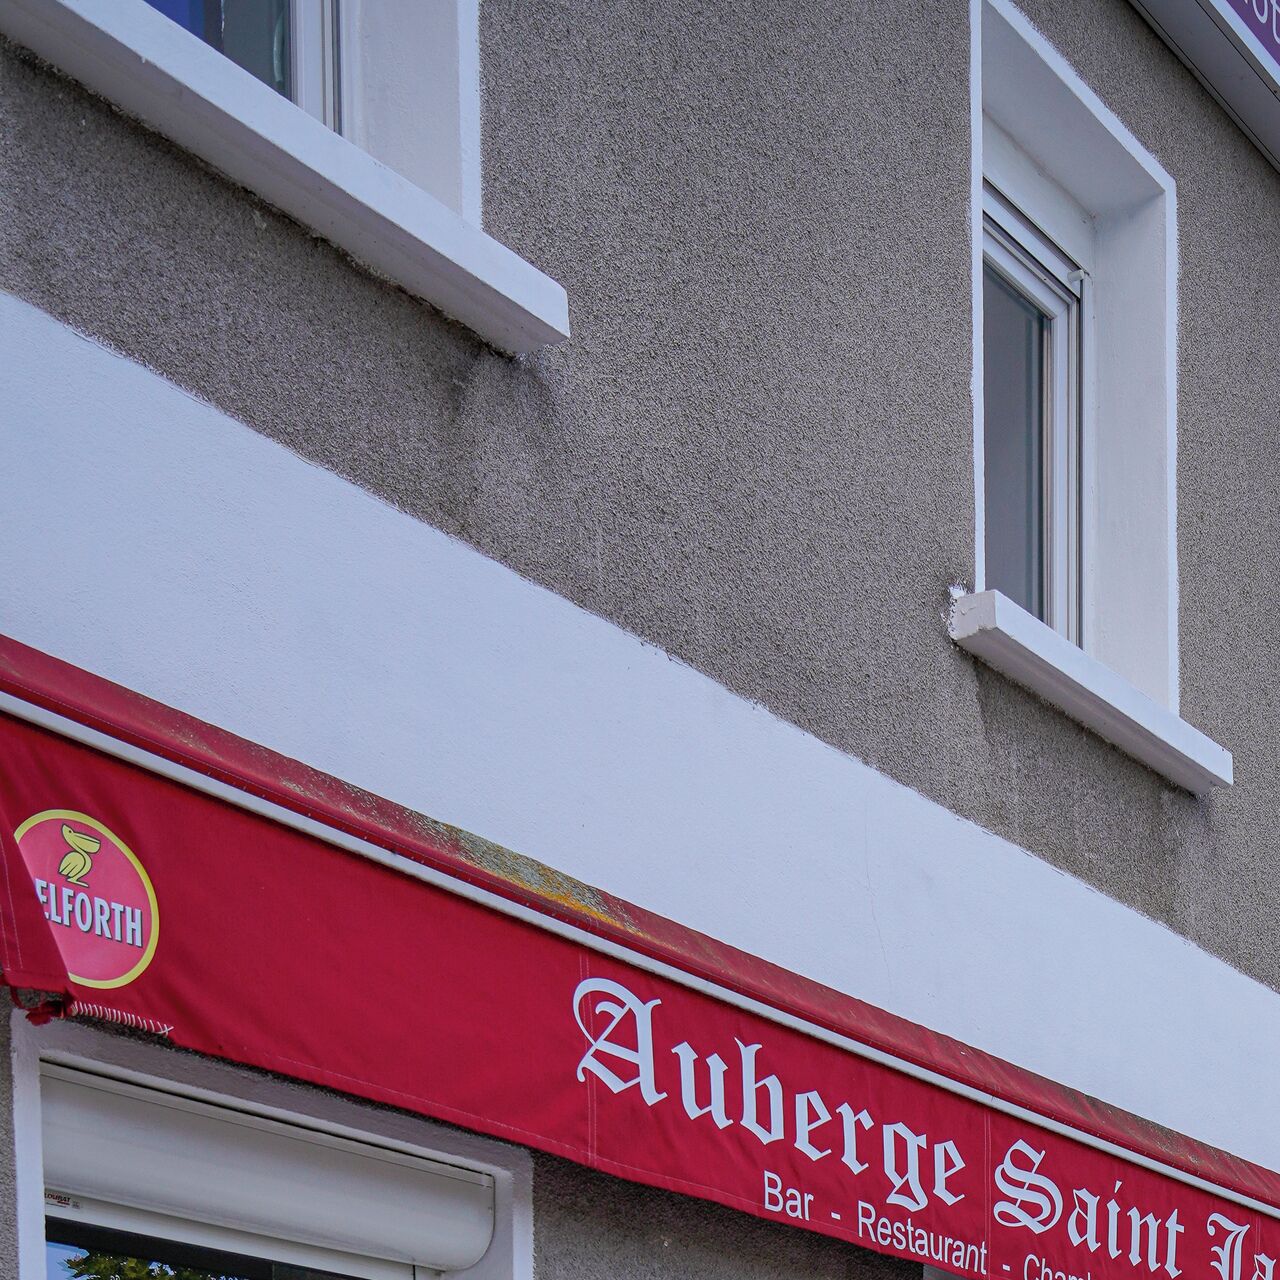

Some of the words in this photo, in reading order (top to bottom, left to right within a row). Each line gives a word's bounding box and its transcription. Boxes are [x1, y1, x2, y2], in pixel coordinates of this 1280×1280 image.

[34, 876, 144, 949] ELFORTH
[572, 976, 967, 1213] Auberge
[992, 1138, 1185, 1279] Saint
[763, 1169, 814, 1221] Bar
[857, 1200, 988, 1276] Restaurant
